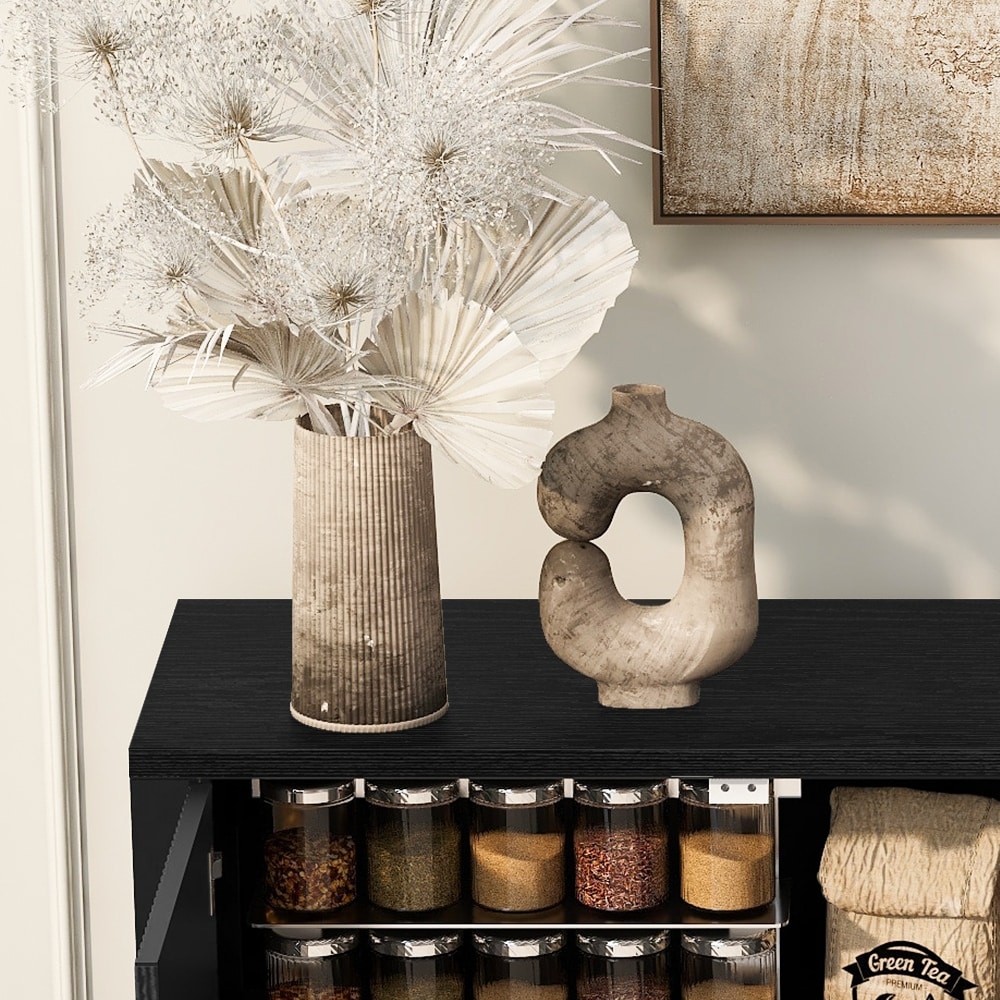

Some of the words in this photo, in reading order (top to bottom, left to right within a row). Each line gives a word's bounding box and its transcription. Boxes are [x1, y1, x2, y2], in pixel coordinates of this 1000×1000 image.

[868, 953, 915, 973] Green
[920, 957, 951, 985] Tea
[885, 978, 923, 991] PREMIUM
